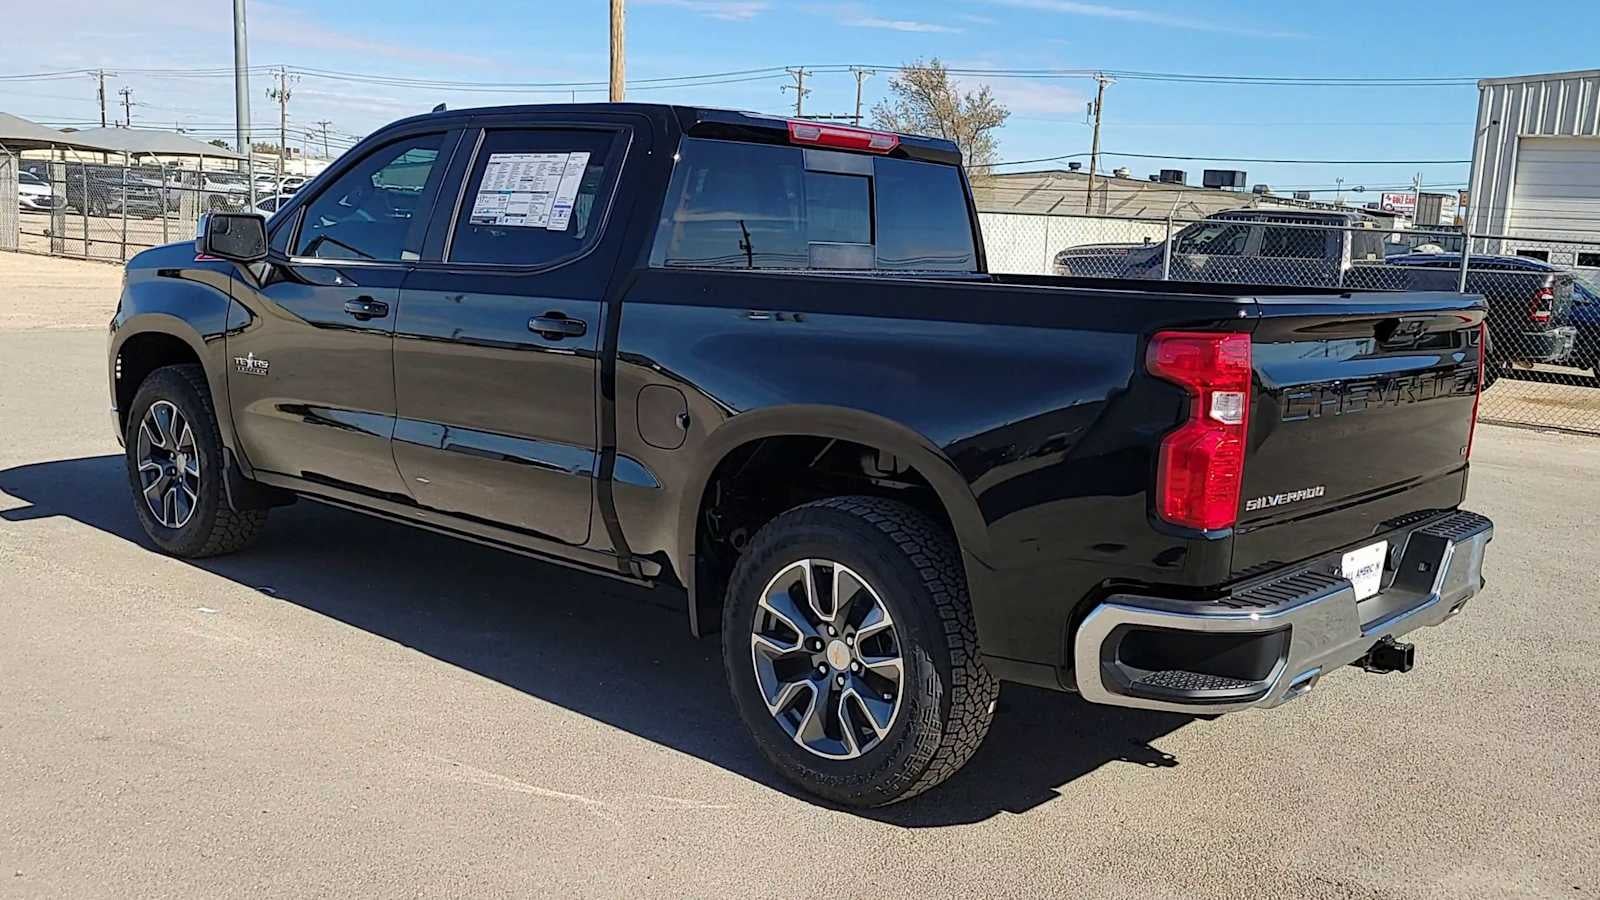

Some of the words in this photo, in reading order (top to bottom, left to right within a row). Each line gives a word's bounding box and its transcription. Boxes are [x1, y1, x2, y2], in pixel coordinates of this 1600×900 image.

[233, 352, 269, 369] TEXAS
[1245, 486, 1326, 512] SILVERADO
[1355, 560, 1381, 577] AMERICN
